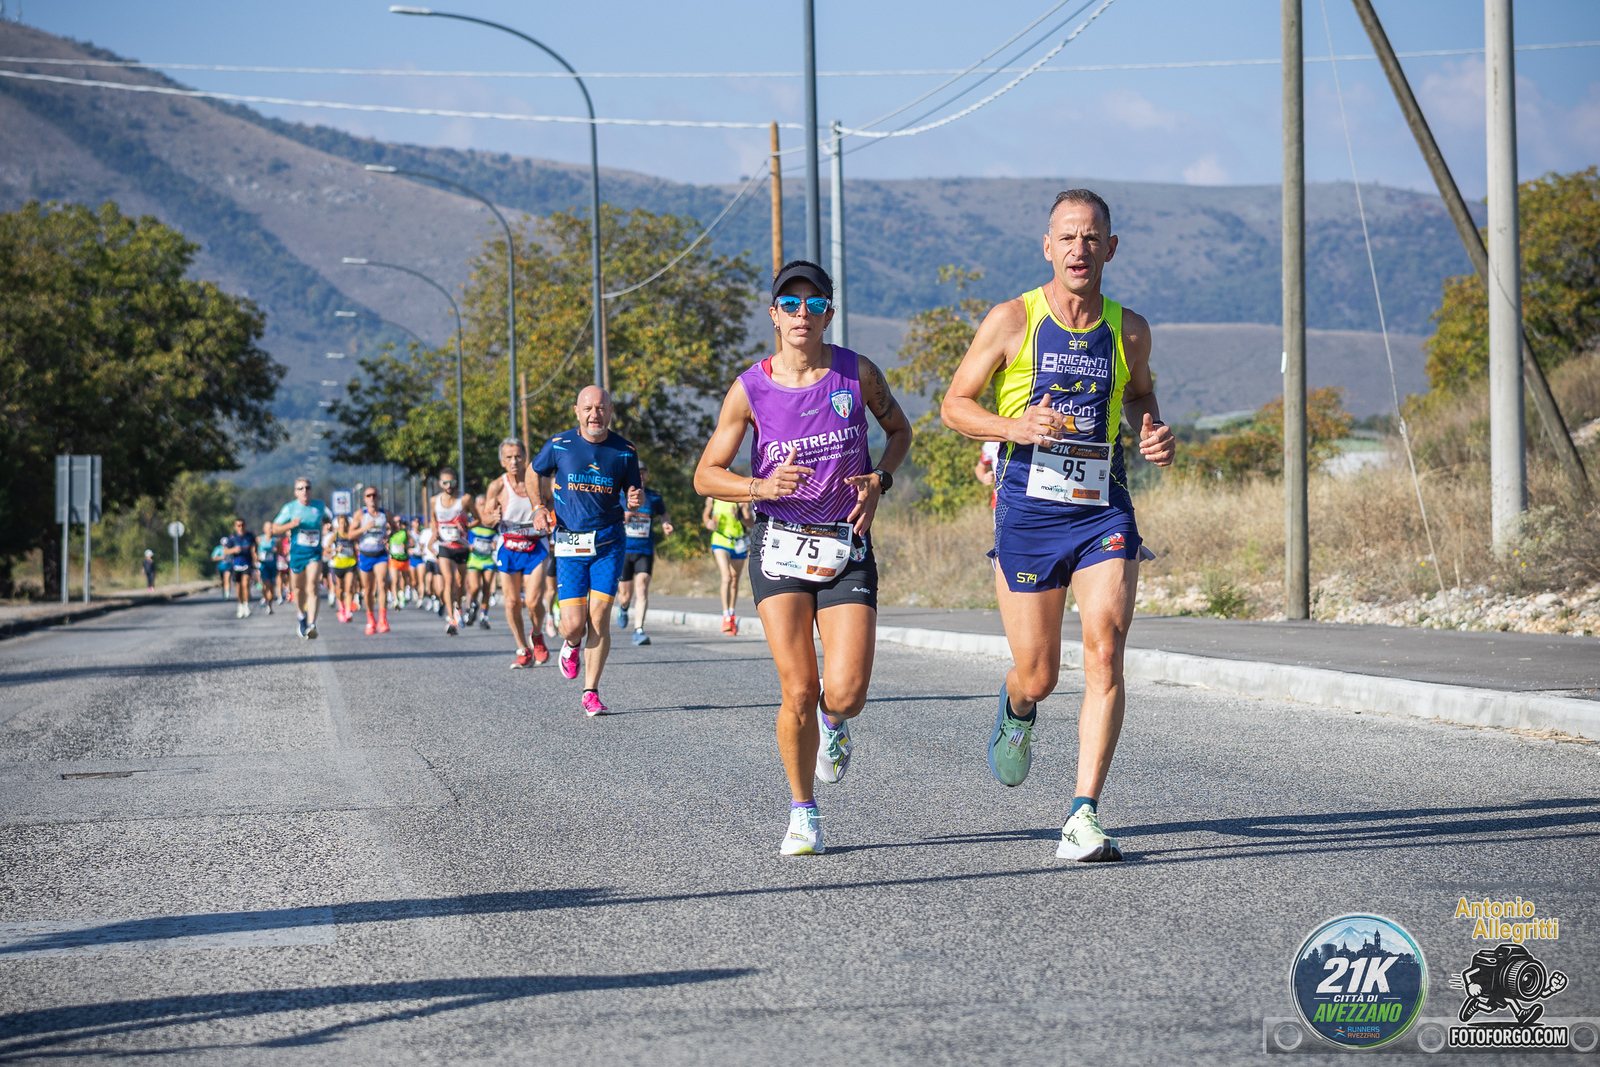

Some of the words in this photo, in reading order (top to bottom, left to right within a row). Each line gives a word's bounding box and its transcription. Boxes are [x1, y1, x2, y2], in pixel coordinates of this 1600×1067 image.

[1041, 353, 1108, 373] BRIGANTI
[1051, 400, 1097, 417] udom
[781, 424, 860, 454] NETREALITY
[1051, 443, 1071, 455] 21K
[1063, 459, 1087, 482] 95
[568, 473, 614, 487] RUNNERS
[568, 482, 613, 494] AVEZZANO
[796, 536, 820, 559] 75
[1016, 571, 1037, 584] S74
